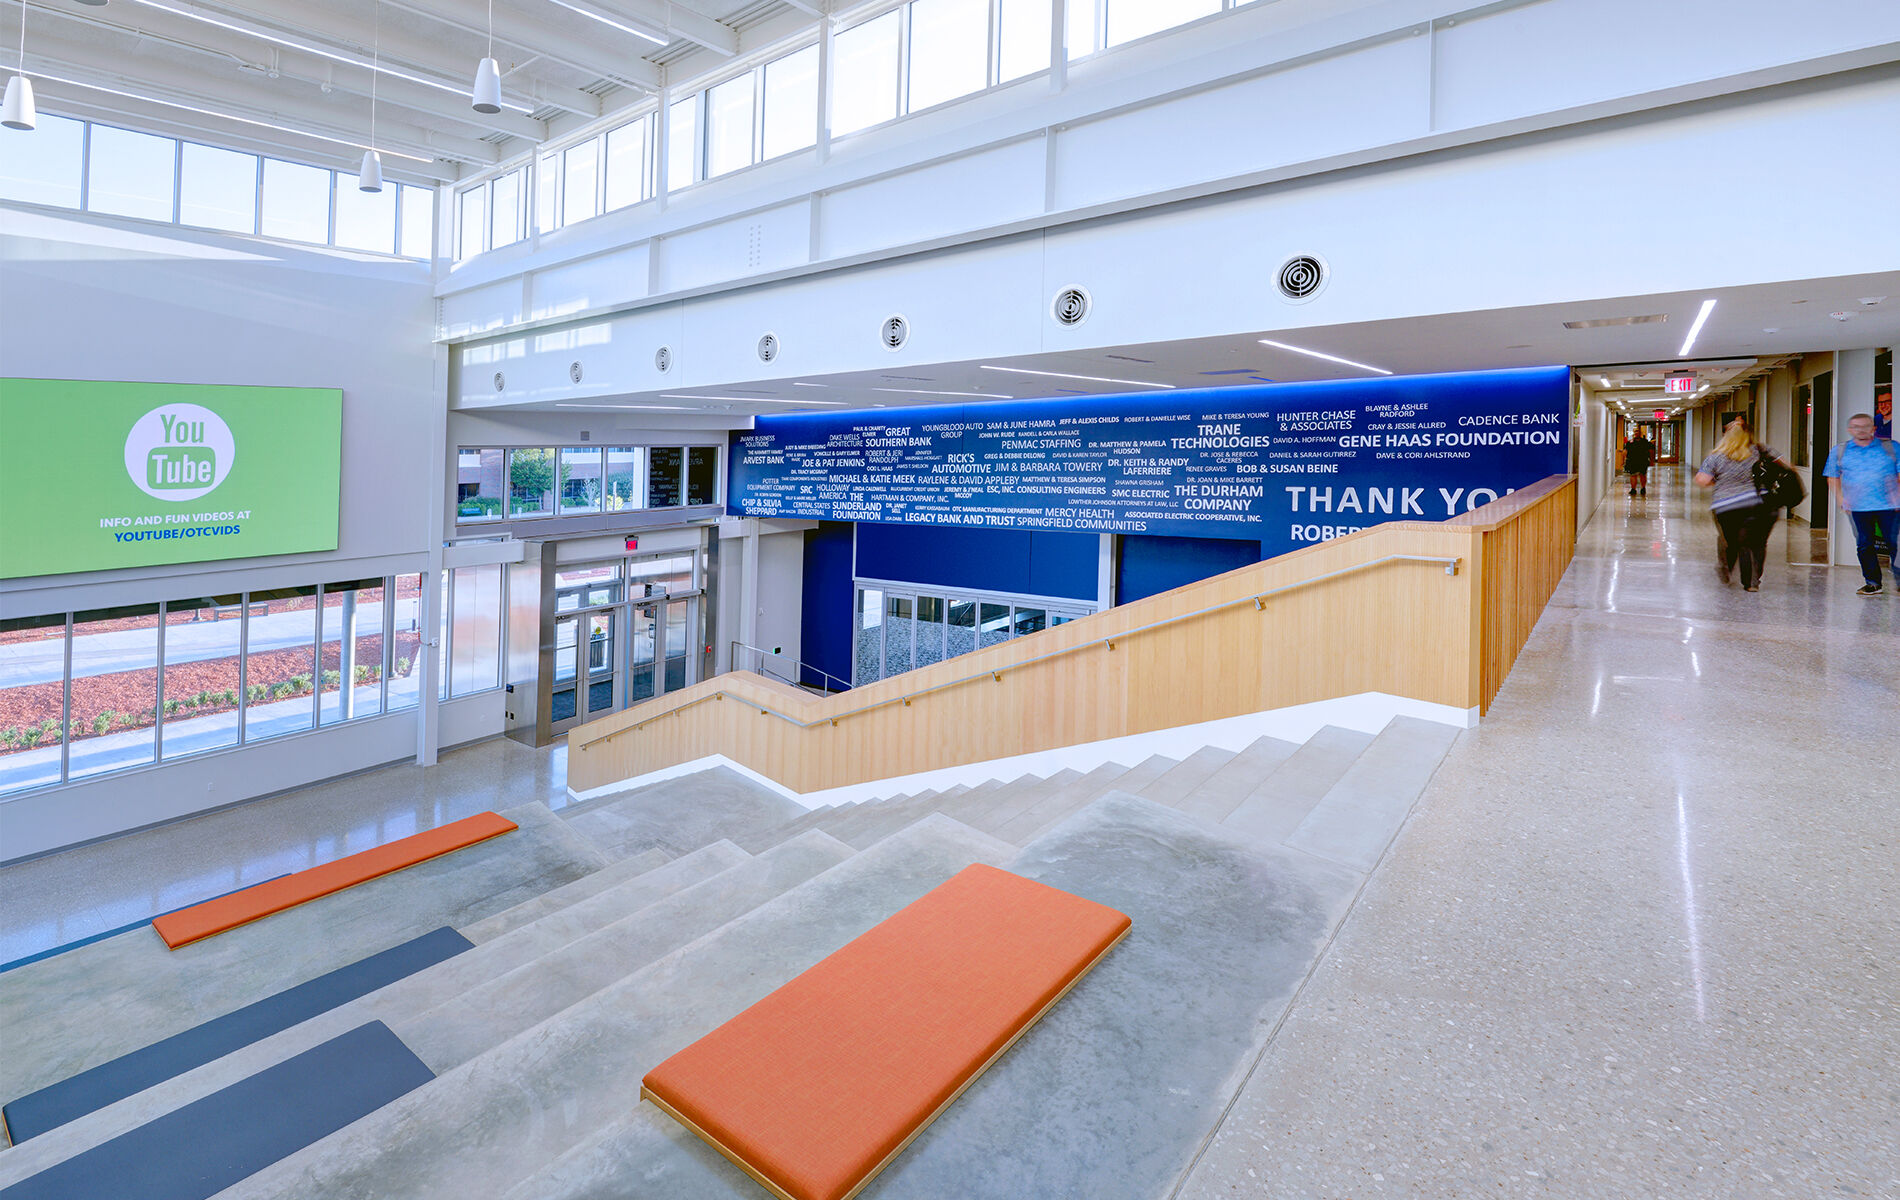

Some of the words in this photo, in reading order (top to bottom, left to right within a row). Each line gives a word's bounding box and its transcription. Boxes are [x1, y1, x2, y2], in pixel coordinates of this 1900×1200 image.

[1671, 379, 1692, 391] EXIT
[1400, 403, 1428, 411] ASHLEE
[1277, 411, 1319, 422] HUNTER
[1321, 410, 1356, 420] CHASE
[1380, 410, 1414, 418] RADFORD
[1458, 415, 1519, 427] CADENCE
[1522, 414, 1559, 425] BANK
[160, 414, 204, 443] You
[1198, 424, 1241, 436] TRANE
[1280, 421, 1287, 431] &
[1290, 420, 1352, 431] ASSOCIATES
[1395, 422, 1416, 430] JESSIE
[886, 427, 911, 436] GREAT
[866, 438, 906, 446] SOUTHERN
[909, 437, 931, 445] BANK
[1171, 436, 1269, 449] TECHNOLOGIES
[1339, 434, 1381, 447] GENE
[1385, 433, 1431, 447] HAAS
[1436, 431, 1560, 446] FOUNDATION
[1002, 440, 1038, 449] PENMAC
[1040, 439, 1081, 448] STAFFING
[948, 454, 974, 463] RICK'S
[1404, 451, 1422, 459] CORI
[1424, 451, 1470, 459] AHLSTRAND
[743, 456, 766, 464] ARVEST
[767, 456, 784, 464] BANK
[815, 459, 821, 467] &
[822, 459, 835, 467] PAT
[836, 458, 865, 466] JENKINS
[1149, 458, 1157, 466] &
[1159, 458, 1189, 466] RANDY
[152, 454, 211, 483] Tube
[932, 464, 991, 473] AUTOMOTIVE
[995, 464, 1009, 472] JIM
[1011, 463, 1018, 471] &
[1020, 463, 1061, 472] BARBARA
[1063, 462, 1102, 471] TOWERY
[1123, 467, 1171, 475] LAFERRIERE
[1237, 465, 1258, 473] BOB
[1260, 465, 1268, 473] &
[1270, 465, 1303, 473] SUSAN
[1306, 464, 1338, 473] BEINE
[829, 475, 861, 483] MICHAEL
[863, 475, 869, 483] &
[871, 475, 890, 483] KATIE
[893, 475, 915, 483] MEEK
[918, 476, 949, 484] RAYLENE
[951, 476, 957, 484] &
[959, 476, 983, 484] DAVID
[985, 476, 1019, 484] APPLEBY
[800, 486, 813, 494] SRC
[1017, 486, 1062, 494] CONSULTING
[1132, 490, 1169, 498] ELECTRIC
[1175, 485, 1197, 496] THE
[1201, 486, 1263, 497] DURHAM
[850, 493, 863, 501] THE
[1285, 486, 1425, 516] THANK
[1439, 488, 1515, 516] YO
[833, 502, 881, 511] SUNDERLAND
[1184, 499, 1251, 511] COMPANY
[746, 507, 777, 515] SHEPPARD
[1045, 508, 1076, 517] MERCY
[1079, 509, 1114, 518] HEALTH
[100, 517, 131, 528] INFO
[135, 515, 162, 525] AND
[166, 514, 190, 524] FUN
[192, 511, 234, 522] VIDEOS
[237, 511, 251, 519] AT
[833, 512, 880, 520] FOUNDATION
[906, 513, 935, 522] LEGACY
[938, 514, 962, 523] BANK
[963, 515, 983, 524] AND
[986, 516, 1015, 525] TRUST
[1165, 512, 1194, 520] ELECTRIC
[1195, 513, 1245, 522] COOPERATIVE,
[1017, 517, 1072, 527] SPRINGFIELD
[1075, 519, 1146, 531] COMMUNITIES
[115, 525, 240, 542] YOUTUBE/OTCVIDS
